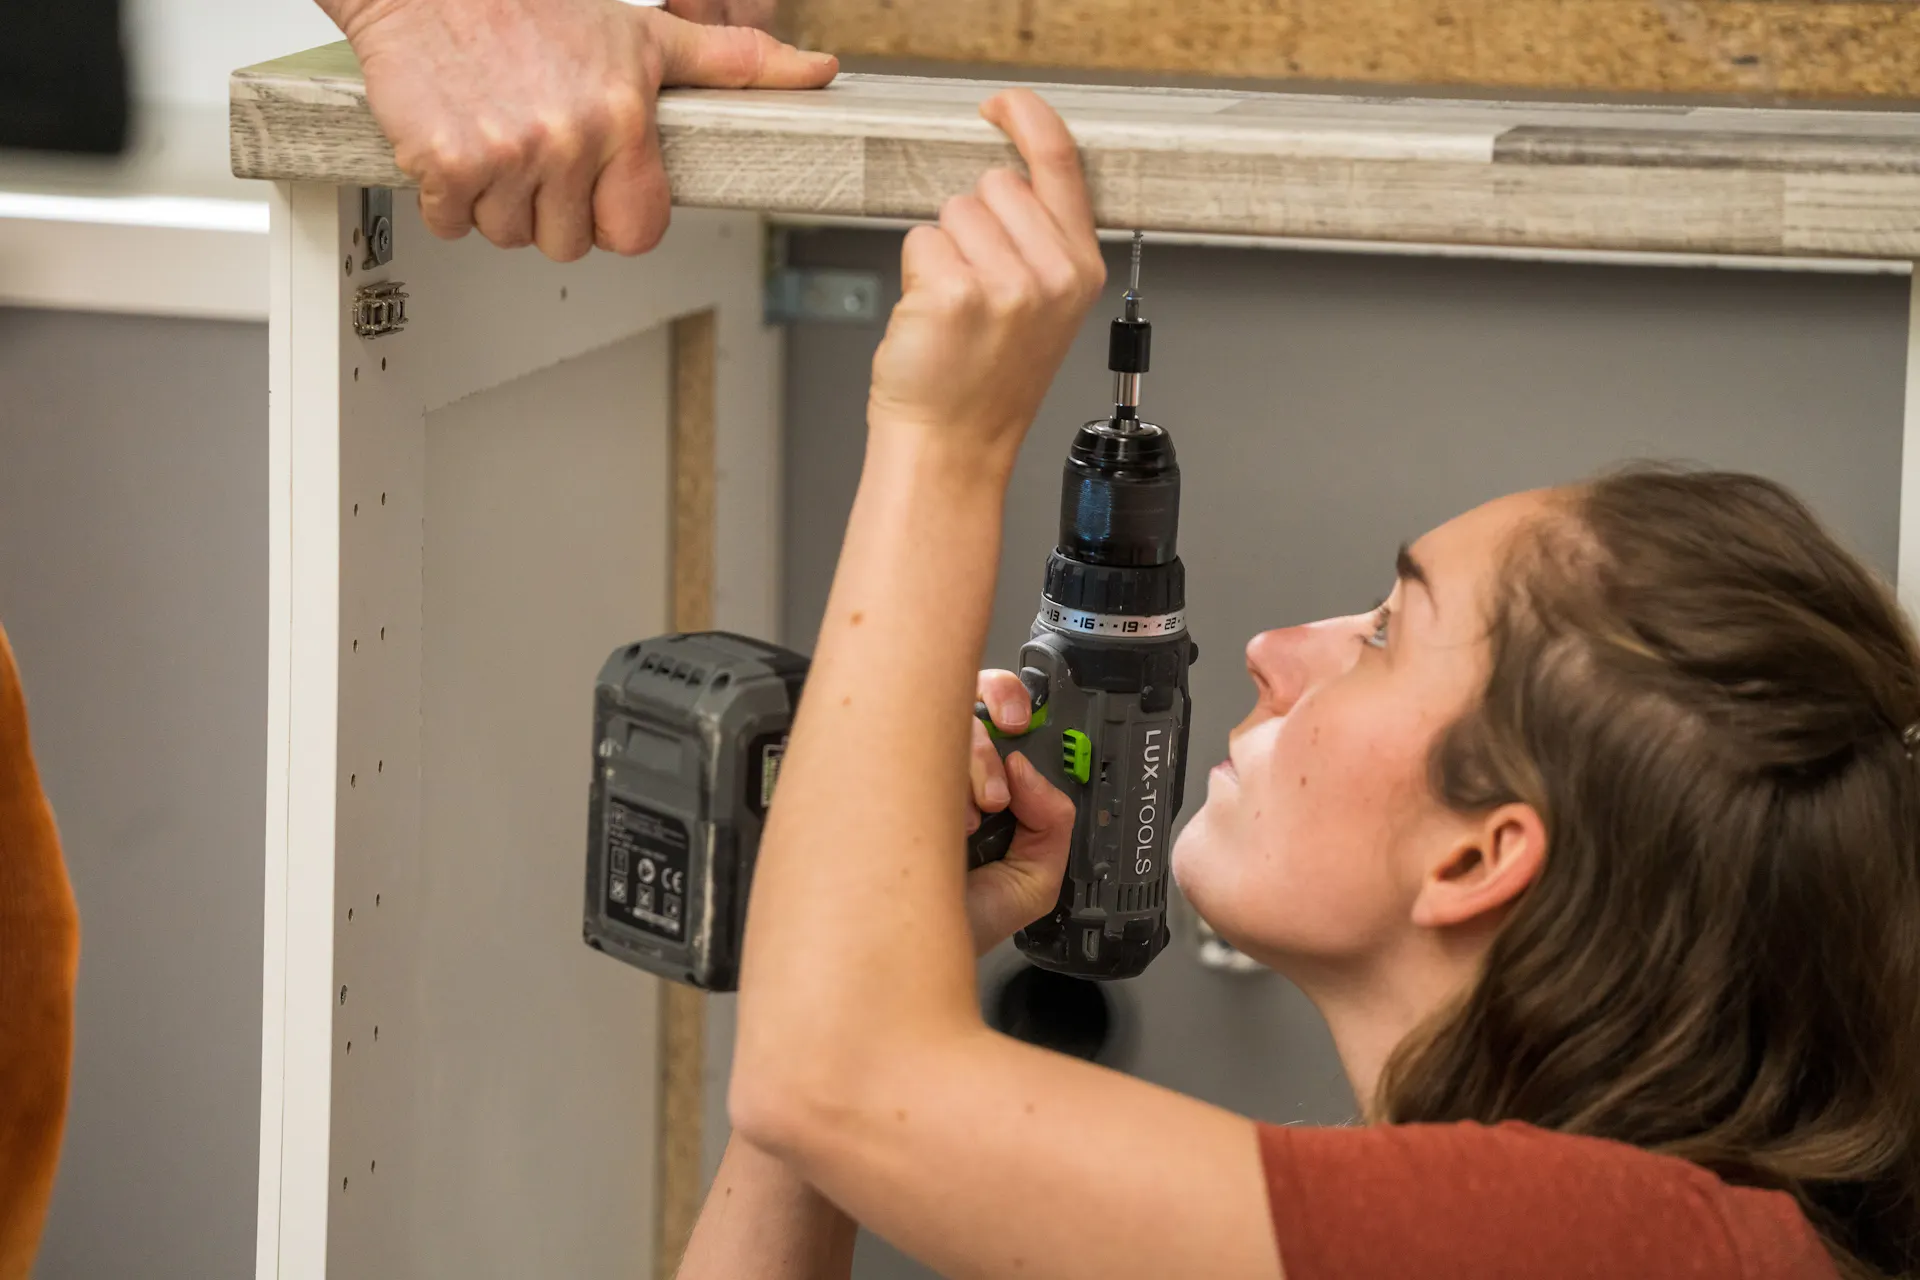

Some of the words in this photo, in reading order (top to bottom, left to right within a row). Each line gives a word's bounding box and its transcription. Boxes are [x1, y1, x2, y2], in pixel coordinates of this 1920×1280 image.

[1050, 609, 1060, 622] 13
[1079, 617, 1095, 630] 16
[1122, 621, 1138, 633] 19
[1164, 617, 1177, 631] 22
[1135, 729, 1162, 875] LUX-TOOLS
